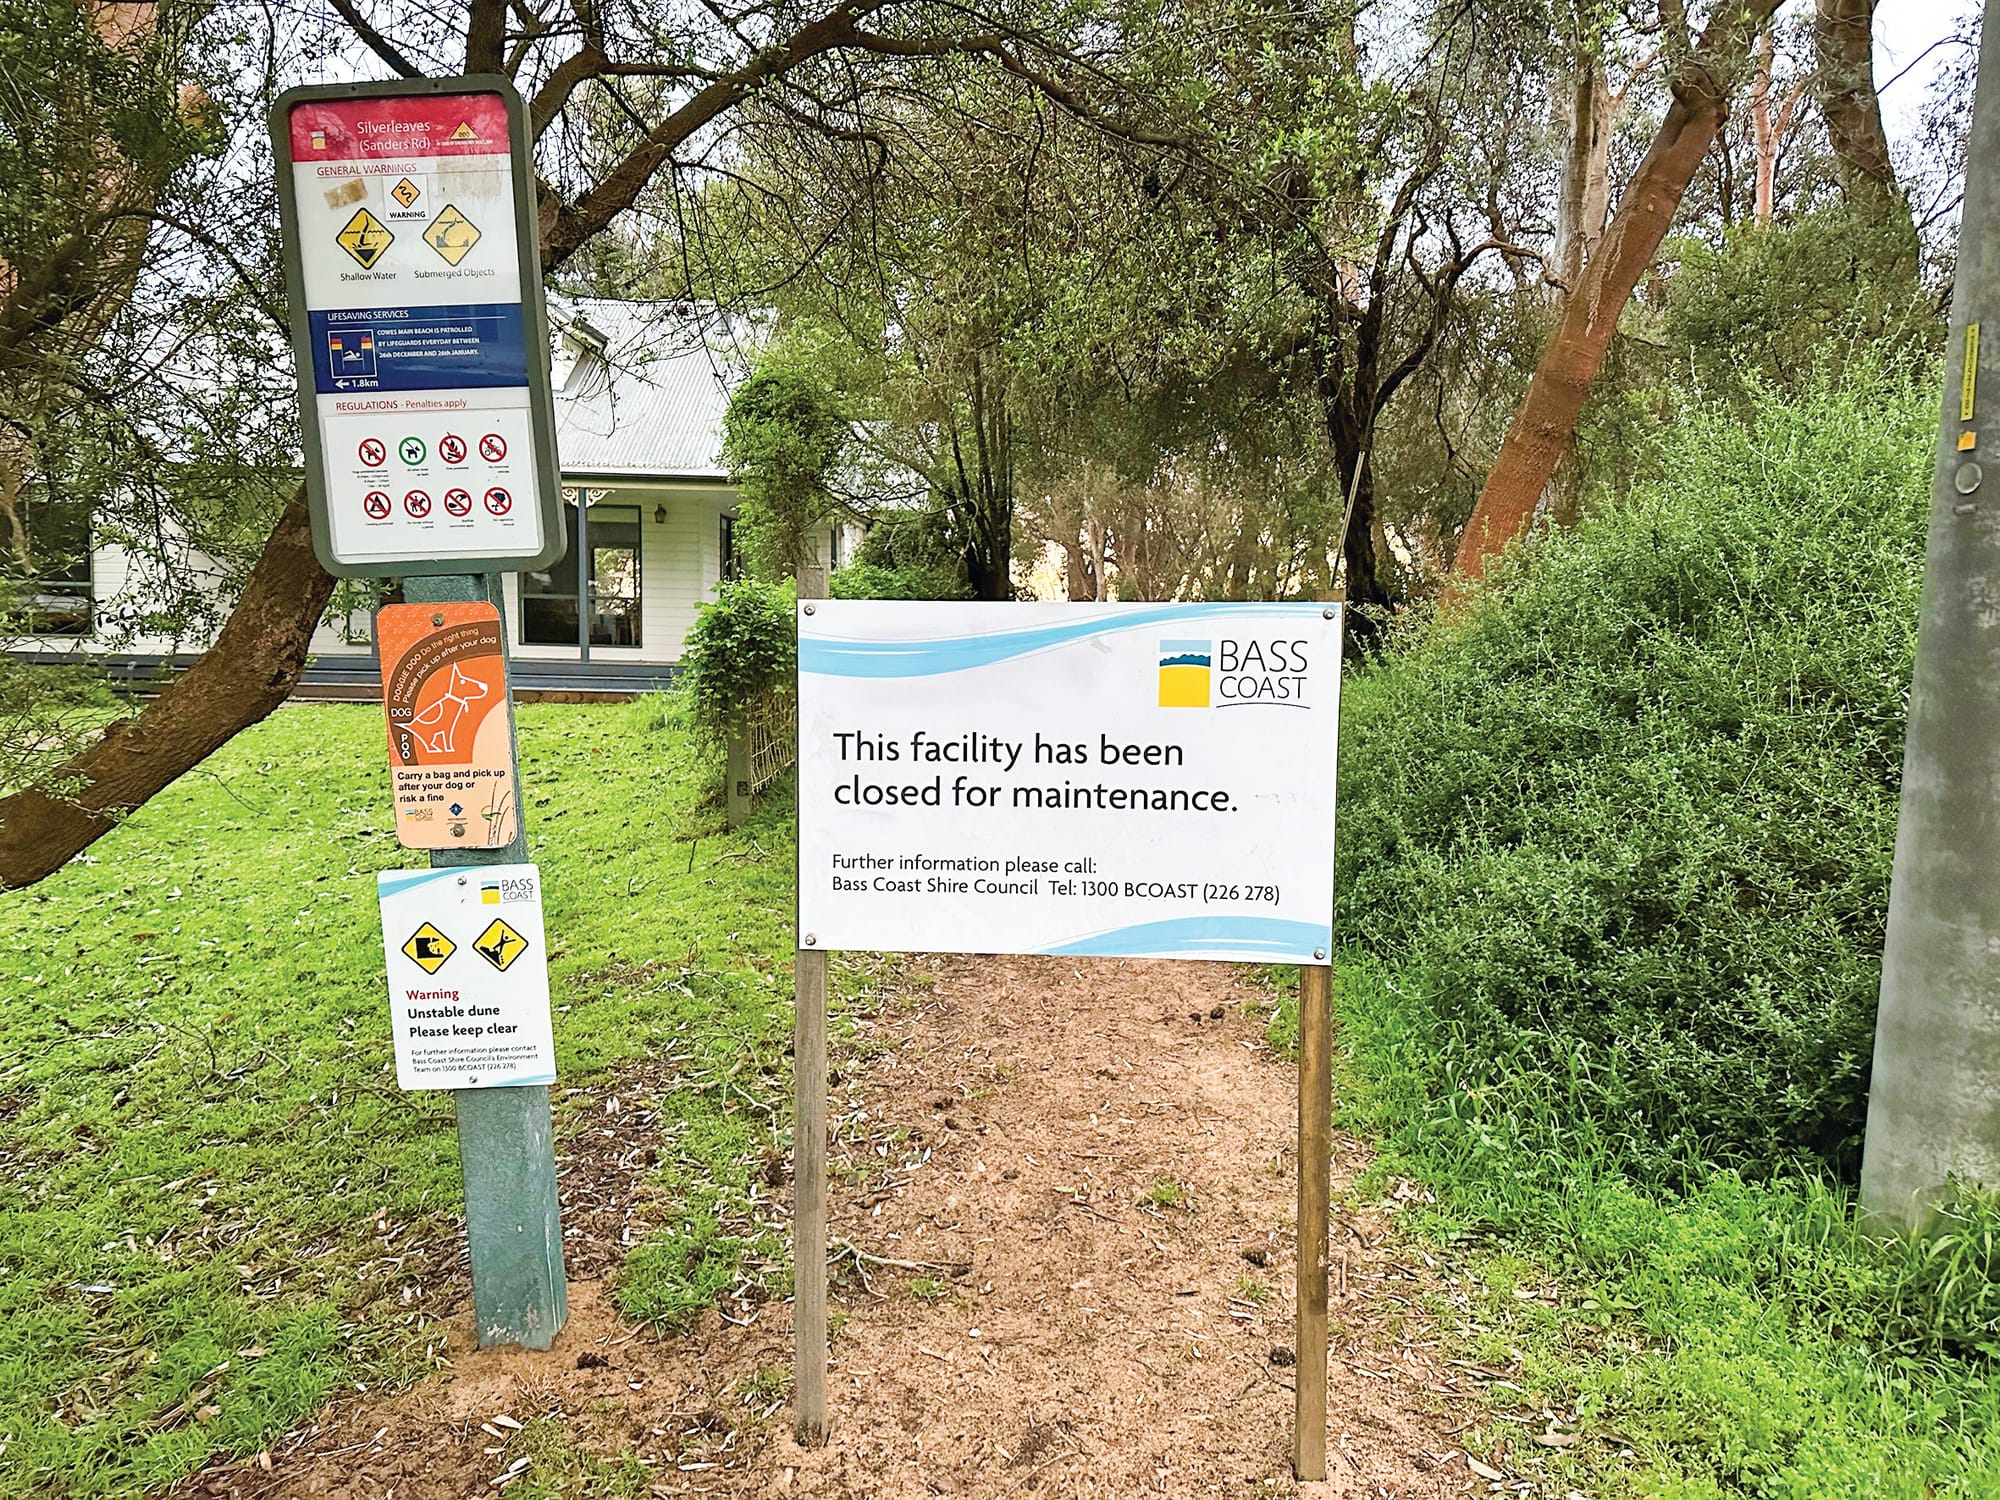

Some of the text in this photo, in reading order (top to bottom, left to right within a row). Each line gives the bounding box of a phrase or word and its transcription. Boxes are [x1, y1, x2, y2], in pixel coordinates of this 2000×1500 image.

[357, 120, 431, 135] Silverleaves
[360, 139, 410, 152] (Sanders
[412, 137, 431, 150] Rd)
[316, 163, 416, 176] GENERAL WARNINGS
[389, 211, 426, 219] WARNING
[340, 270, 398, 281] Shallow Water
[414, 267, 496, 280] Submerged Objects
[328, 310, 409, 321] LIFESAVING SERVICES
[440, 326, 473, 334] PATROLLED
[422, 338, 451, 346] EVERYDAY
[393, 350, 424, 358] DECEMBER
[452, 348, 480, 356] JANUARY.
[352, 379, 379, 388] 1.8km
[336, 400, 398, 411] REGULATIONS
[405, 399, 442, 408] Penalties
[444, 398, 468, 409] apply
[1220, 640, 1308, 674] BASS
[393, 628, 479, 702] DOGGIE DOO Do the right thing
[402, 636, 497, 704] Please pick up after your dog
[1220, 676, 1308, 700] COAST
[391, 708, 412, 718] DOG
[401, 734, 410, 760] POO
[833, 731, 1184, 772] This facility has been
[398, 772, 422, 781] Carry
[433, 771, 451, 780] bag
[453, 770, 470, 778] and
[473, 769, 492, 780] pick
[494, 770, 506, 779] up
[398, 783, 420, 791] after
[422, 782, 442, 792] your
[445, 782, 463, 791] dog
[399, 795, 417, 803] risk
[427, 794, 445, 802] fine
[833, 776, 1238, 814] closed for maintenance.
[832, 854, 1098, 878] Further information please call:
[502, 878, 534, 892] BASS
[832, 876, 1281, 906] Bass Coast Shire Council Tel: 1300 BCOAST (226 278)
[502, 891, 534, 900] COAST
[406, 988, 460, 1002] Warning
[407, 1004, 500, 1020] Unstable dune
[409, 1022, 518, 1039] Please keep clear
[424, 1048, 448, 1056] further
[449, 1047, 488, 1055] information
[488, 1046, 510, 1054] please
